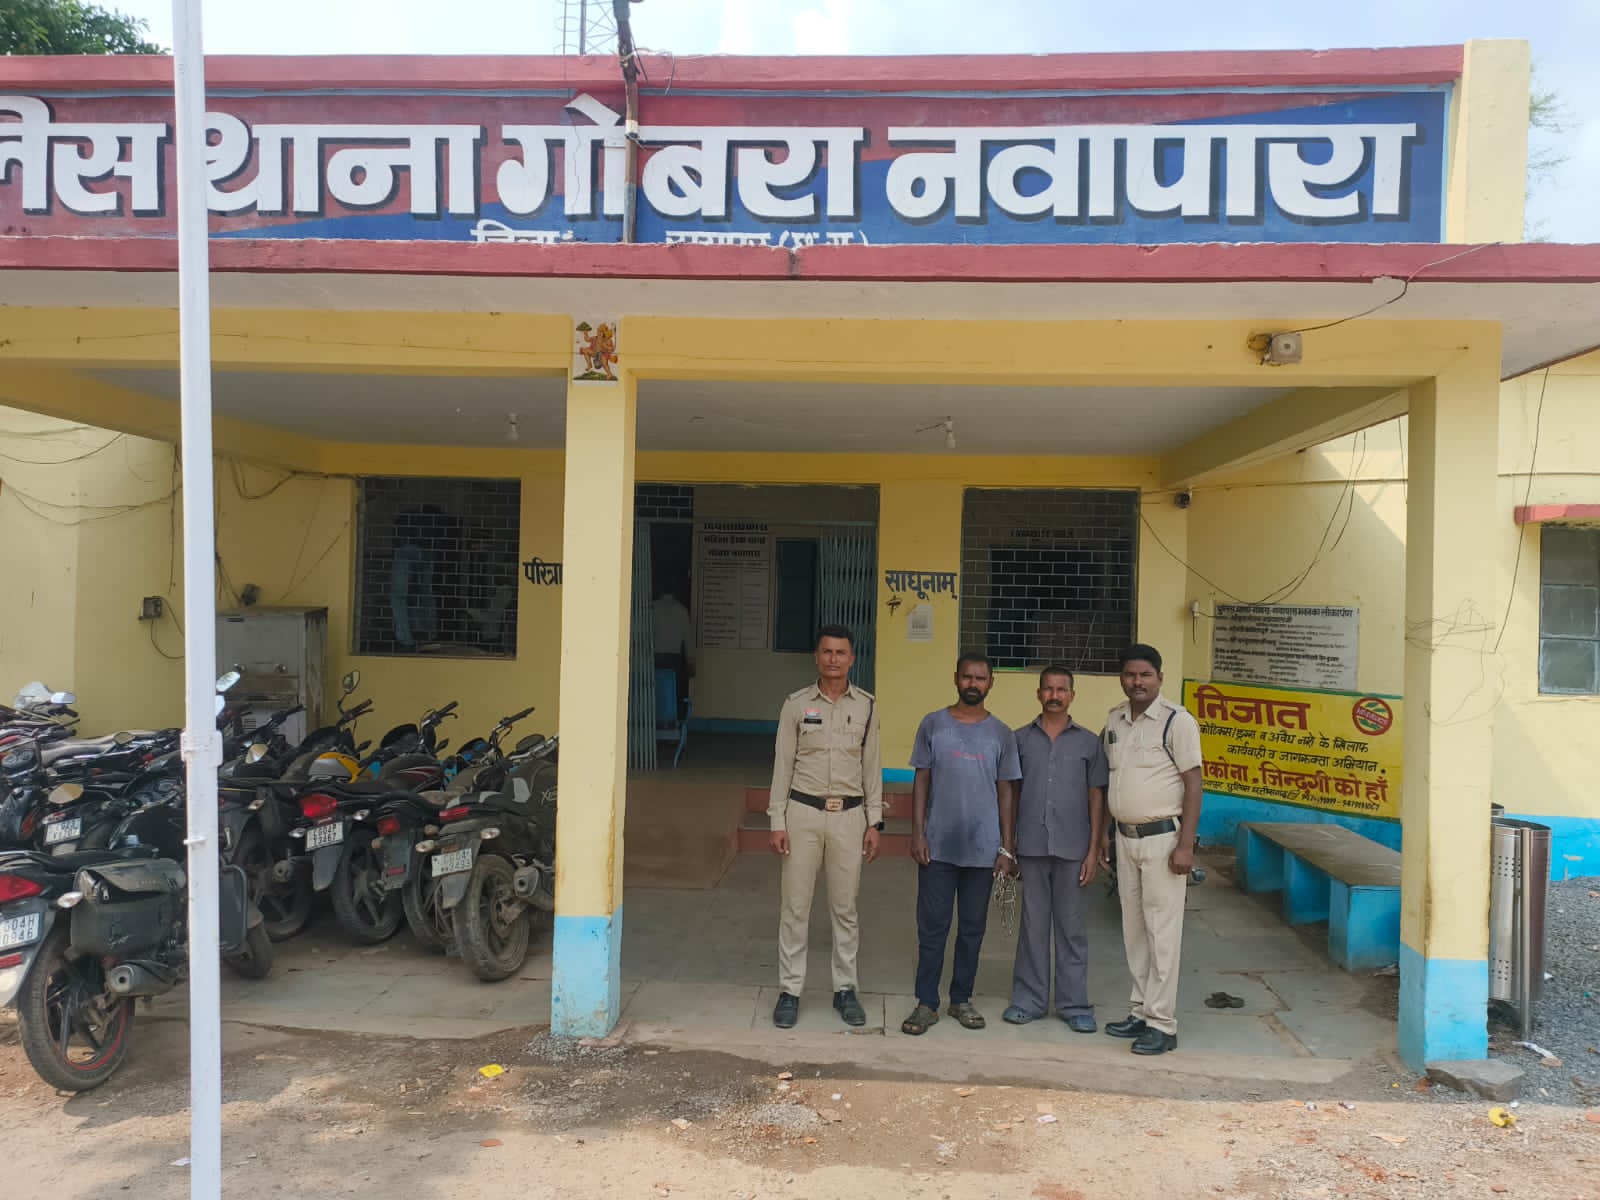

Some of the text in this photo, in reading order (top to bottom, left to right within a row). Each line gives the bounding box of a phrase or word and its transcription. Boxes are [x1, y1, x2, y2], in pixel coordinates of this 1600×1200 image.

[205, 111, 483, 216] थाना
[497, 93, 865, 218] गोबरा
[886, 122, 1417, 218] नवापारा
[1193, 684, 1311, 731] निजात
[1268, 729, 1297, 744] अवैध
[1319, 730, 1330, 749] के
[1333, 736, 1369, 753] खिलाफ
[1332, 773, 1362, 798] को
[1364, 775, 1389, 804] हाँ
